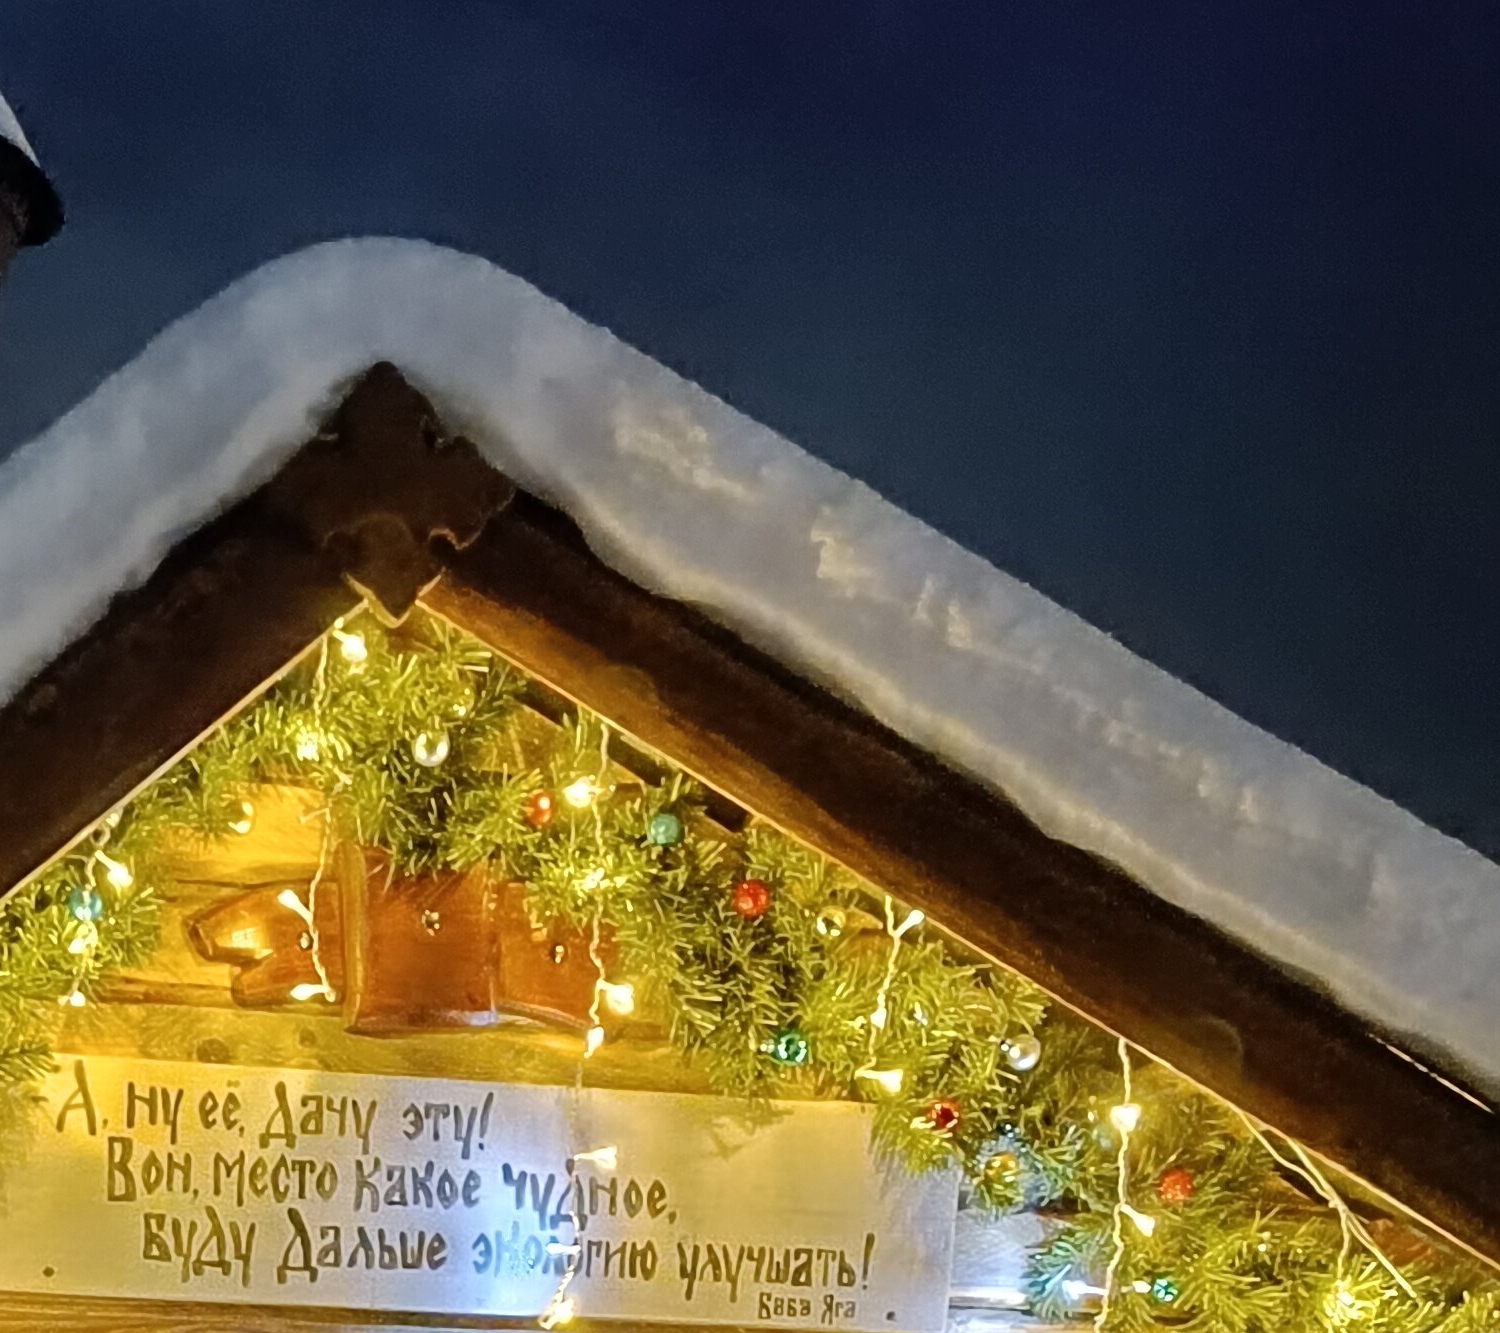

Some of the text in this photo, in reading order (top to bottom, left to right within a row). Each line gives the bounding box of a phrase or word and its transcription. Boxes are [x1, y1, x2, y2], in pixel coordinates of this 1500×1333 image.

[126, 1080, 184, 1146] ну
[198, 1079, 245, 1138] её,
[402, 1091, 494, 1161] эту!
[106, 1135, 199, 1203] Вон,
[676, 1232, 876, 1304] улучшать!
[820, 1294, 857, 1325] Яга
